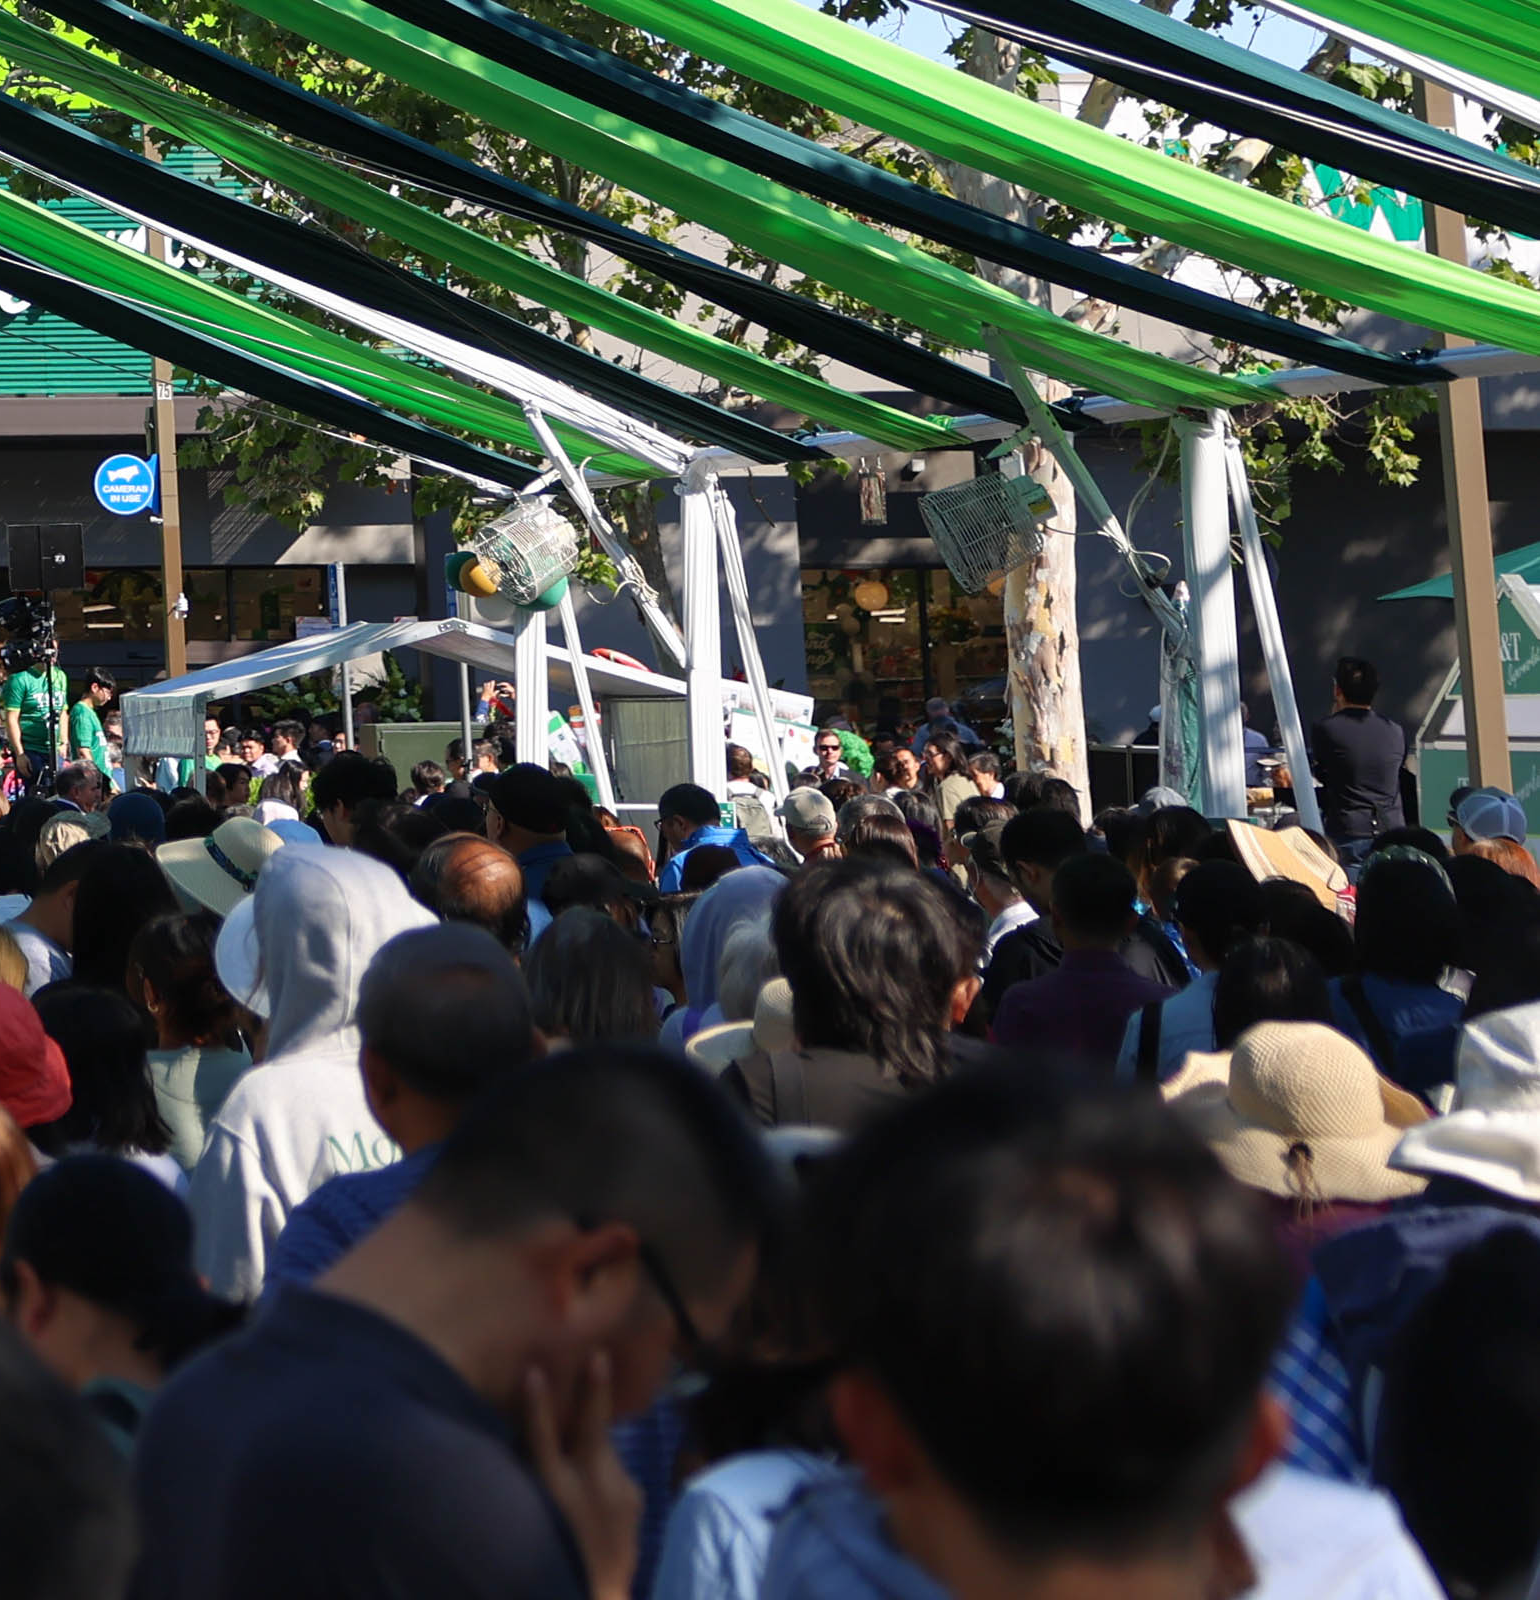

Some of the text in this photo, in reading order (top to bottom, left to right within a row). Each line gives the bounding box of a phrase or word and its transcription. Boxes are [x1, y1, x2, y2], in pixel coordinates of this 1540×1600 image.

[159, 383, 170, 398] 75
[102, 485, 148, 493] CAMERAS
[110, 494, 141, 502] IN USE
